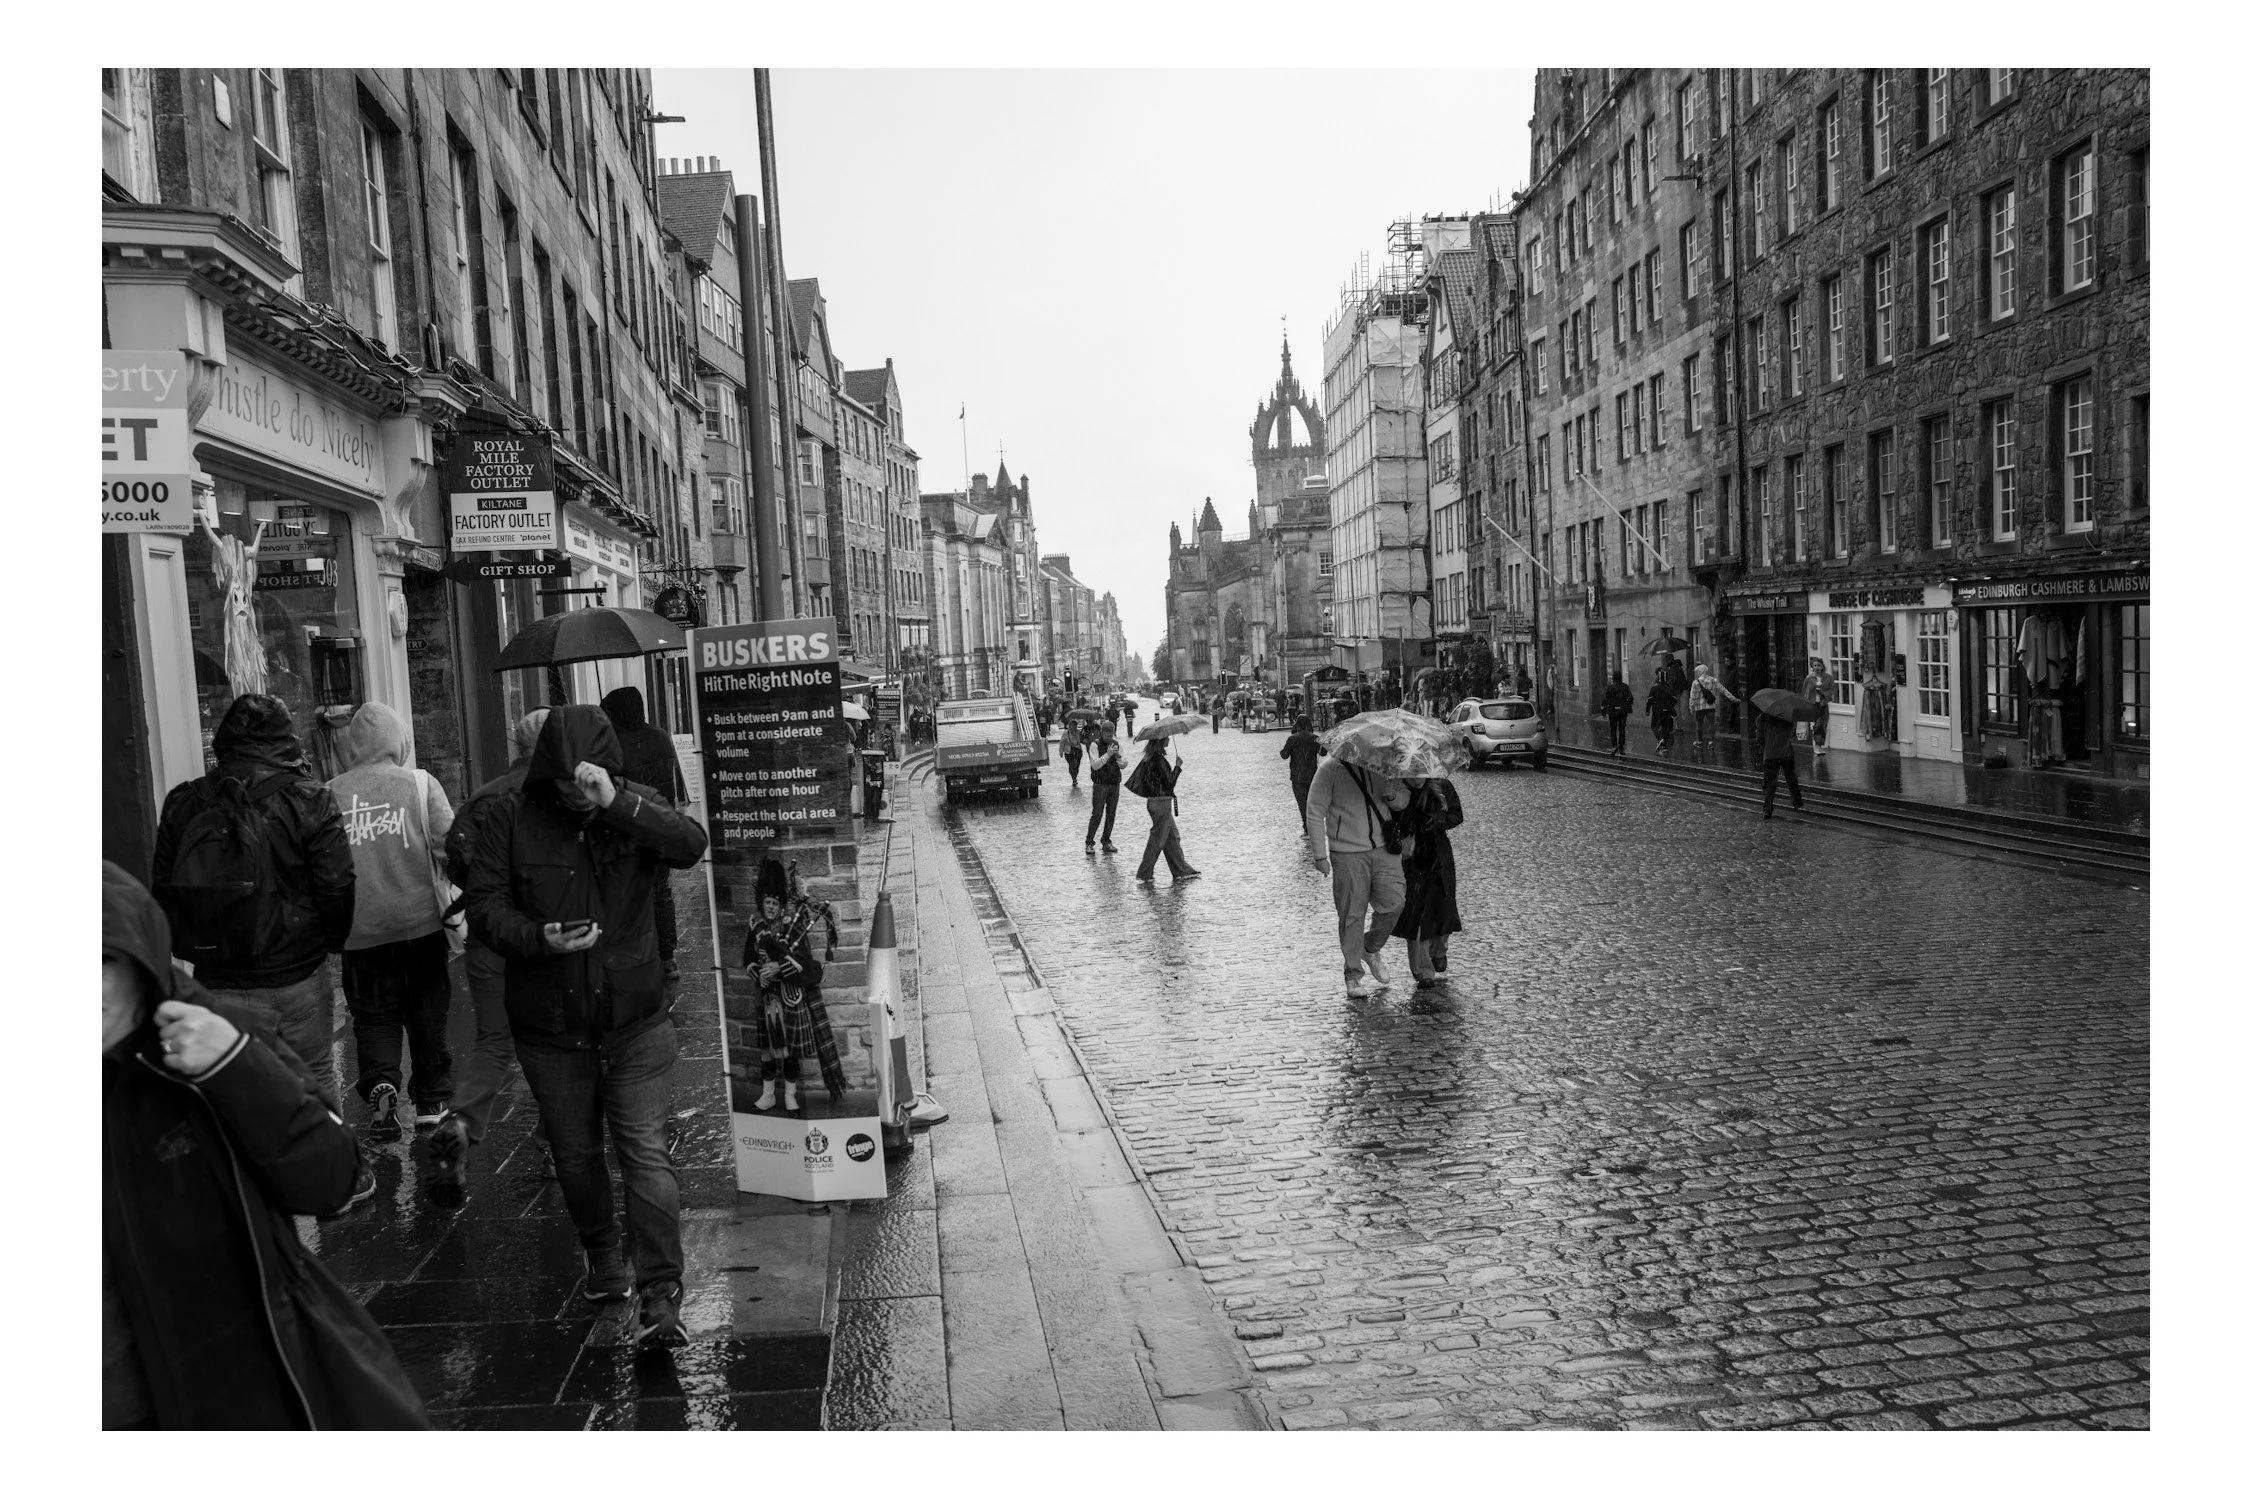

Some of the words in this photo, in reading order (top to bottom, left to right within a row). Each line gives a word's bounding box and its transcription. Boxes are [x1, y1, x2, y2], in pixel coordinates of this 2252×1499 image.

[217, 364, 282, 434] histle
[290, 393, 314, 447] do
[320, 406, 374, 483] Nicely
[474, 440, 524, 452] ROYAL
[480, 452, 520, 464] MILE
[465, 464, 534, 477] FACTORY
[470, 476, 532, 490] OUTLET
[482, 498, 523, 509] KILTANE
[455, 514, 506, 530] FACTORY
[508, 512, 551, 528] OUTLET
[456, 536, 467, 544] TAX
[468, 535, 492, 544] REFUND
[493, 534, 516, 543] CENTRE
[480, 566, 514, 576] GIFT
[518, 564, 556, 575] SHOP
[1978, 584, 2028, 600] EDINBURGH
[2031, 579, 2084, 596] CASHMERE
[2088, 579, 2098, 593] &
[1747, 598, 1756, 609] The
[1757, 597, 1774, 611] Whisky
[1775, 596, 1787, 608] Trail
[702, 632, 830, 668] BUSKERS
[748, 672, 789, 693] Right
[790, 668, 832, 688] Note
[714, 713, 736, 726] Busk
[737, 710, 779, 724] between
[782, 710, 808, 722] 9am
[812, 706, 835, 720] and
[716, 731, 735, 745] 9pm
[737, 730, 747, 741] at
[748, 731, 754, 740] a
[756, 725, 823, 740] considerate
[716, 746, 750, 758] volume
[719, 770, 744, 782] Move
[745, 772, 757, 781] on
[758, 770, 769, 780] to
[771, 767, 818, 780] another
[720, 786, 744, 800] pitch
[744, 786, 767, 798] after
[768, 786, 790, 797] one
[792, 784, 820, 796] hour
[723, 810, 759, 822] Respect
[760, 808, 776, 821] the
[778, 808, 807, 821] local
[809, 808, 836, 820] area
[724, 826, 741, 838] and
[743, 826, 776, 840] people
